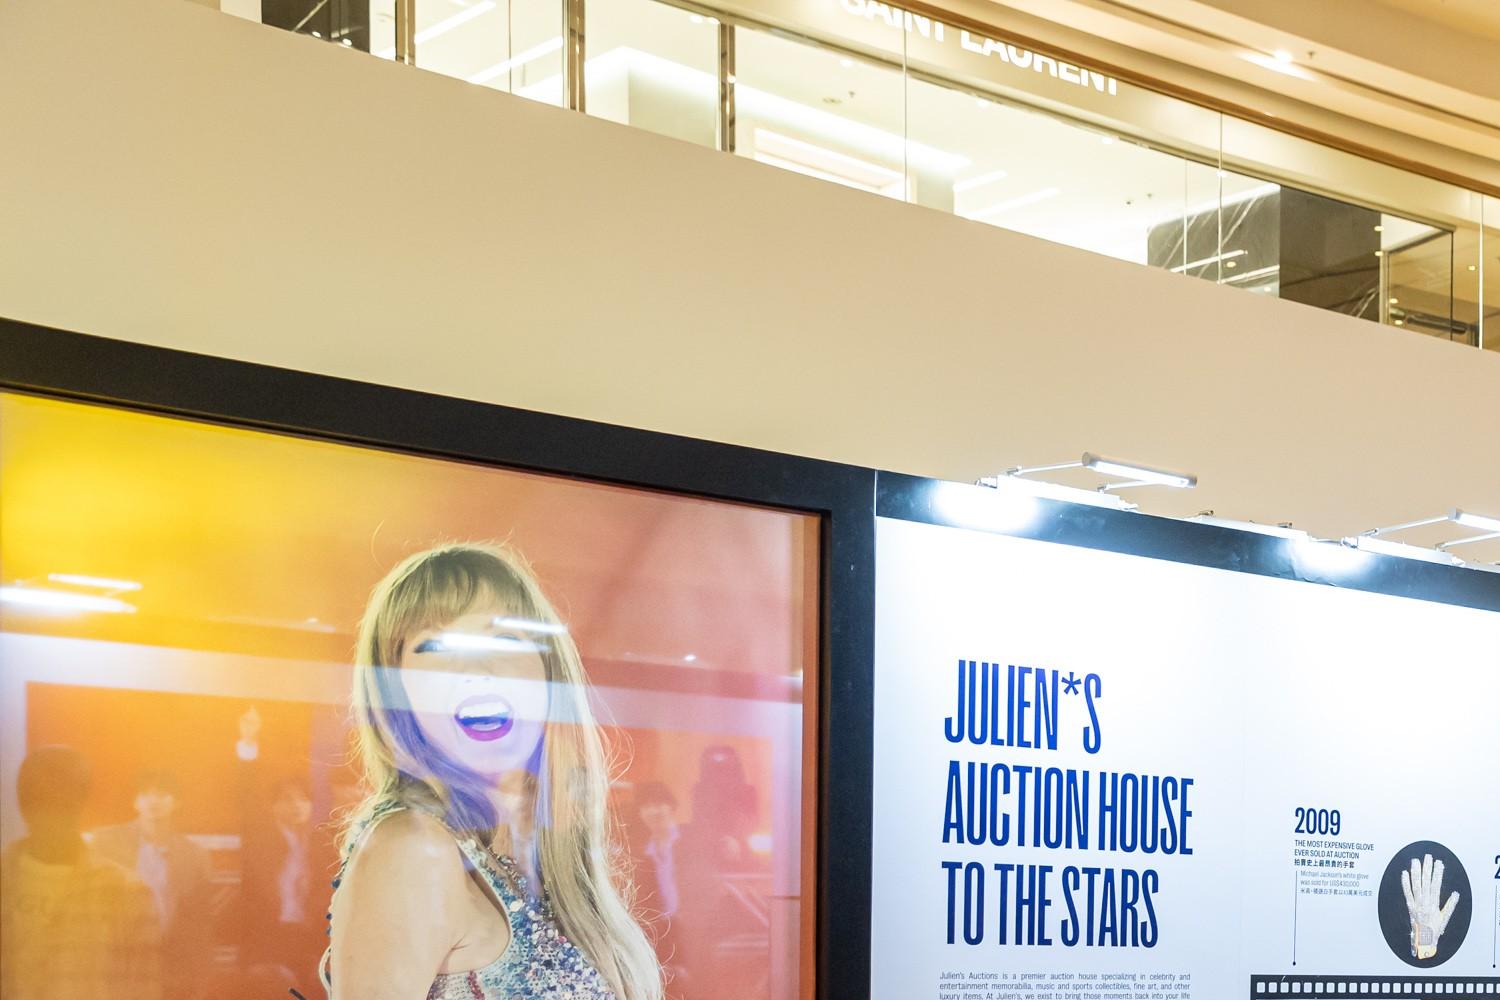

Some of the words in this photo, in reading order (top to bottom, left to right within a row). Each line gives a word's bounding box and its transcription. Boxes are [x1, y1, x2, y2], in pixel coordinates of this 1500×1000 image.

[942, 759, 1090, 850] AUCTION
[1098, 771, 1194, 855] HOUSE
[1295, 807, 1341, 835] 2009
[1324, 841, 1355, 850] EXPENSIVE
[1356, 843, 1374, 851] GLOVE
[1334, 851, 1359, 859] AUCTION
[941, 861, 985, 945] TO
[994, 864, 1053, 946] THE
[1061, 865, 1159, 948] STARS
[939, 972, 965, 980] Julien's
[969, 972, 998, 980] Auctions
[1021, 973, 1046, 982] premier
[1071, 983, 1093, 991] sports
[1147, 983, 1158, 991] art,
[939, 993, 960, 1000] luxury
[1064, 993, 1081, 1000] bring
